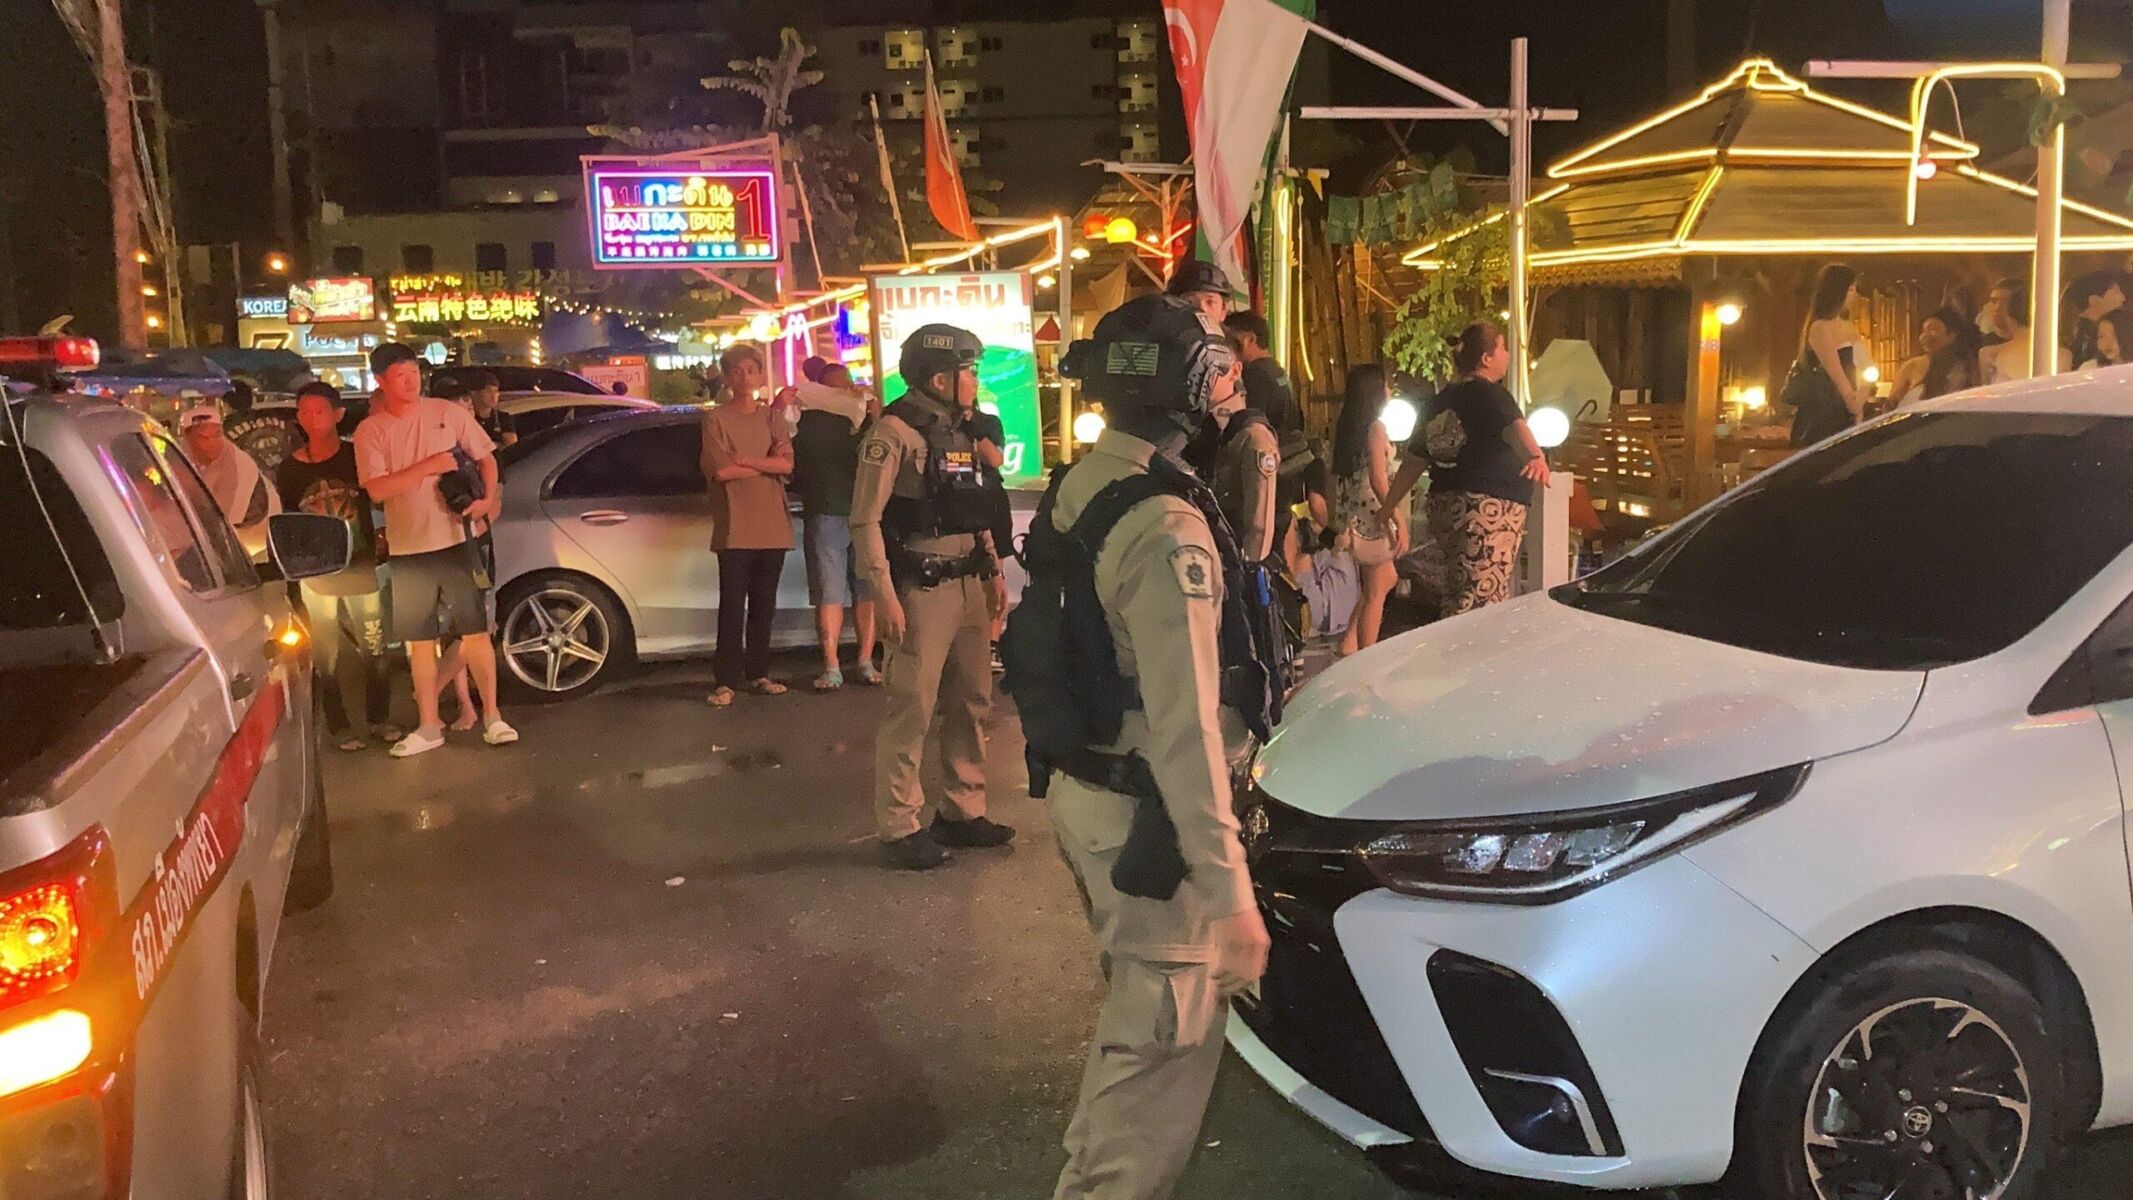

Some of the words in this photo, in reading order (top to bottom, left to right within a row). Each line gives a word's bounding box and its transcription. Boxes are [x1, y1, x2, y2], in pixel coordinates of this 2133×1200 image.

[736, 179, 771, 241] 1
[394, 291, 540, 322] 云南特色绝味
